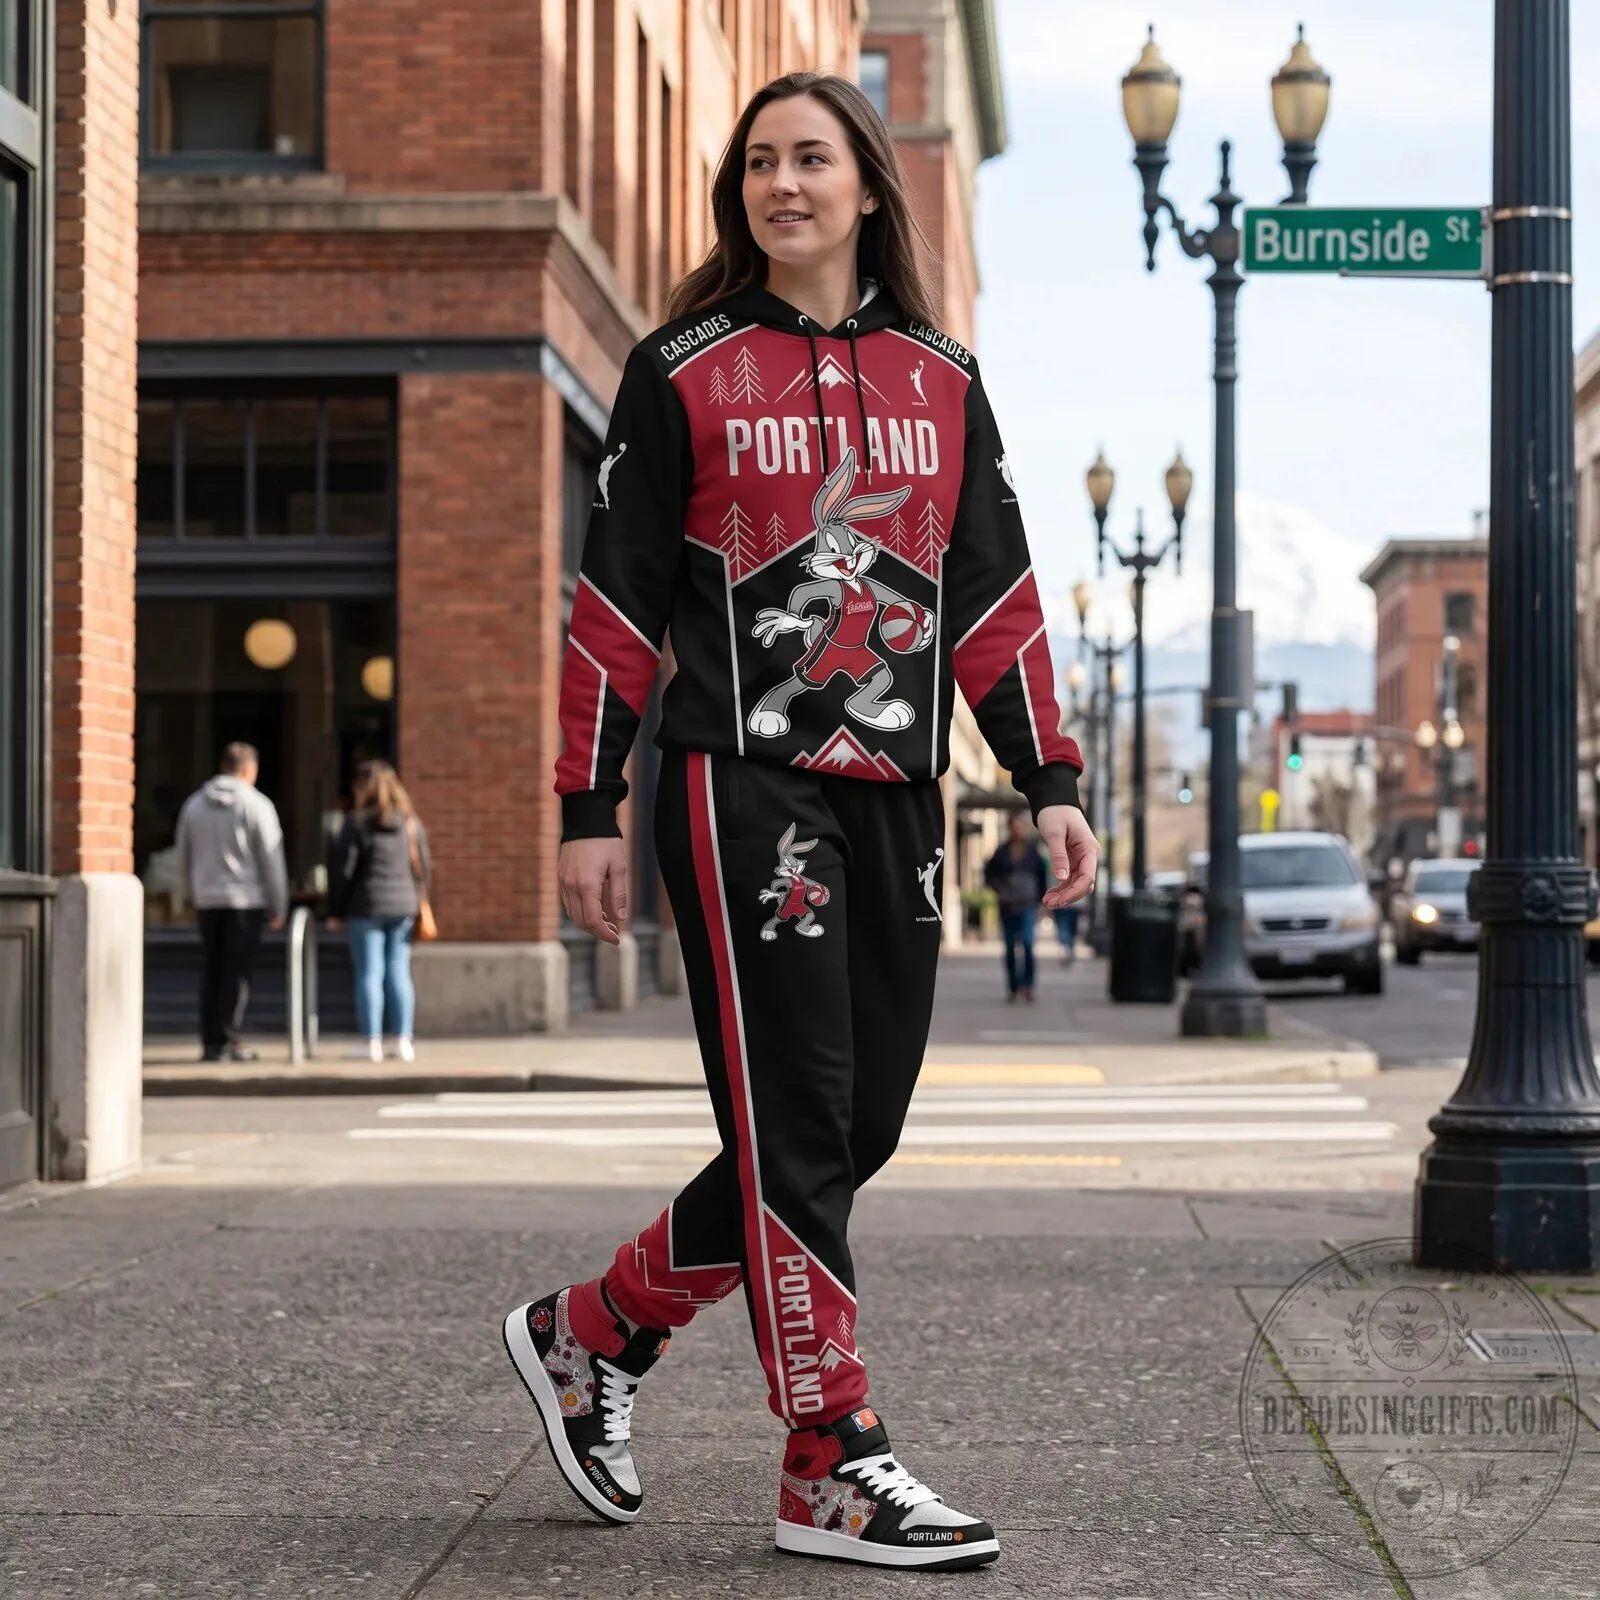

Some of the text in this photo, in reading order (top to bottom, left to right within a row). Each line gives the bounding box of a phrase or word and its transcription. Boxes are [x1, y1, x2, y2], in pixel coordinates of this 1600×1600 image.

[1255, 218, 1430, 262] Burnside
[660, 313, 732, 361] CASCADES
[908, 320, 972, 365] CASCADES
[775, 1254, 825, 1415] PORTLAND
[589, 1465, 617, 1498] PORTLAND
[907, 1532, 953, 1542] PORTLAND
